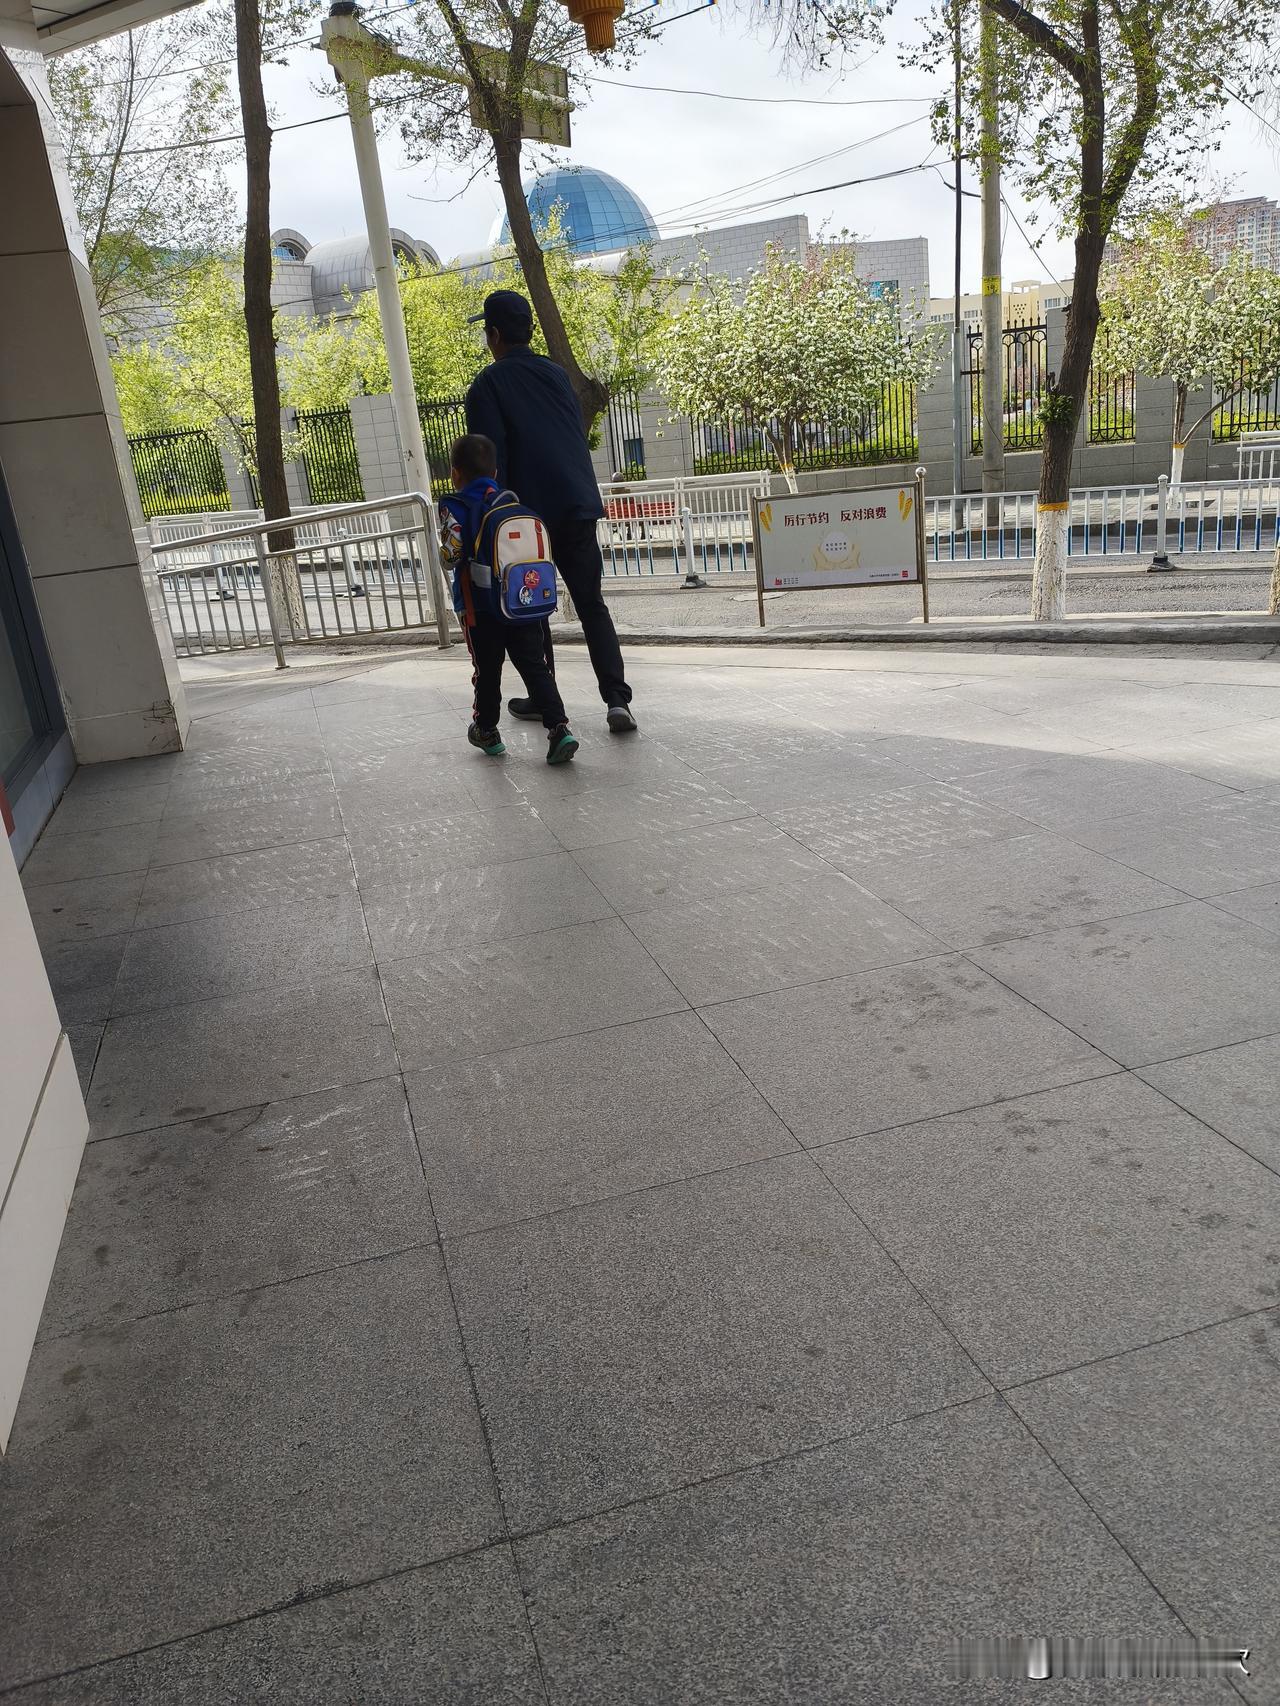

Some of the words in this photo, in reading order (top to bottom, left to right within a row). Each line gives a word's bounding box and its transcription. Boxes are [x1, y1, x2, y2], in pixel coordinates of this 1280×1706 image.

[784, 512, 829, 527] 厉行节约
[840, 506, 887, 522] 反对浪费
